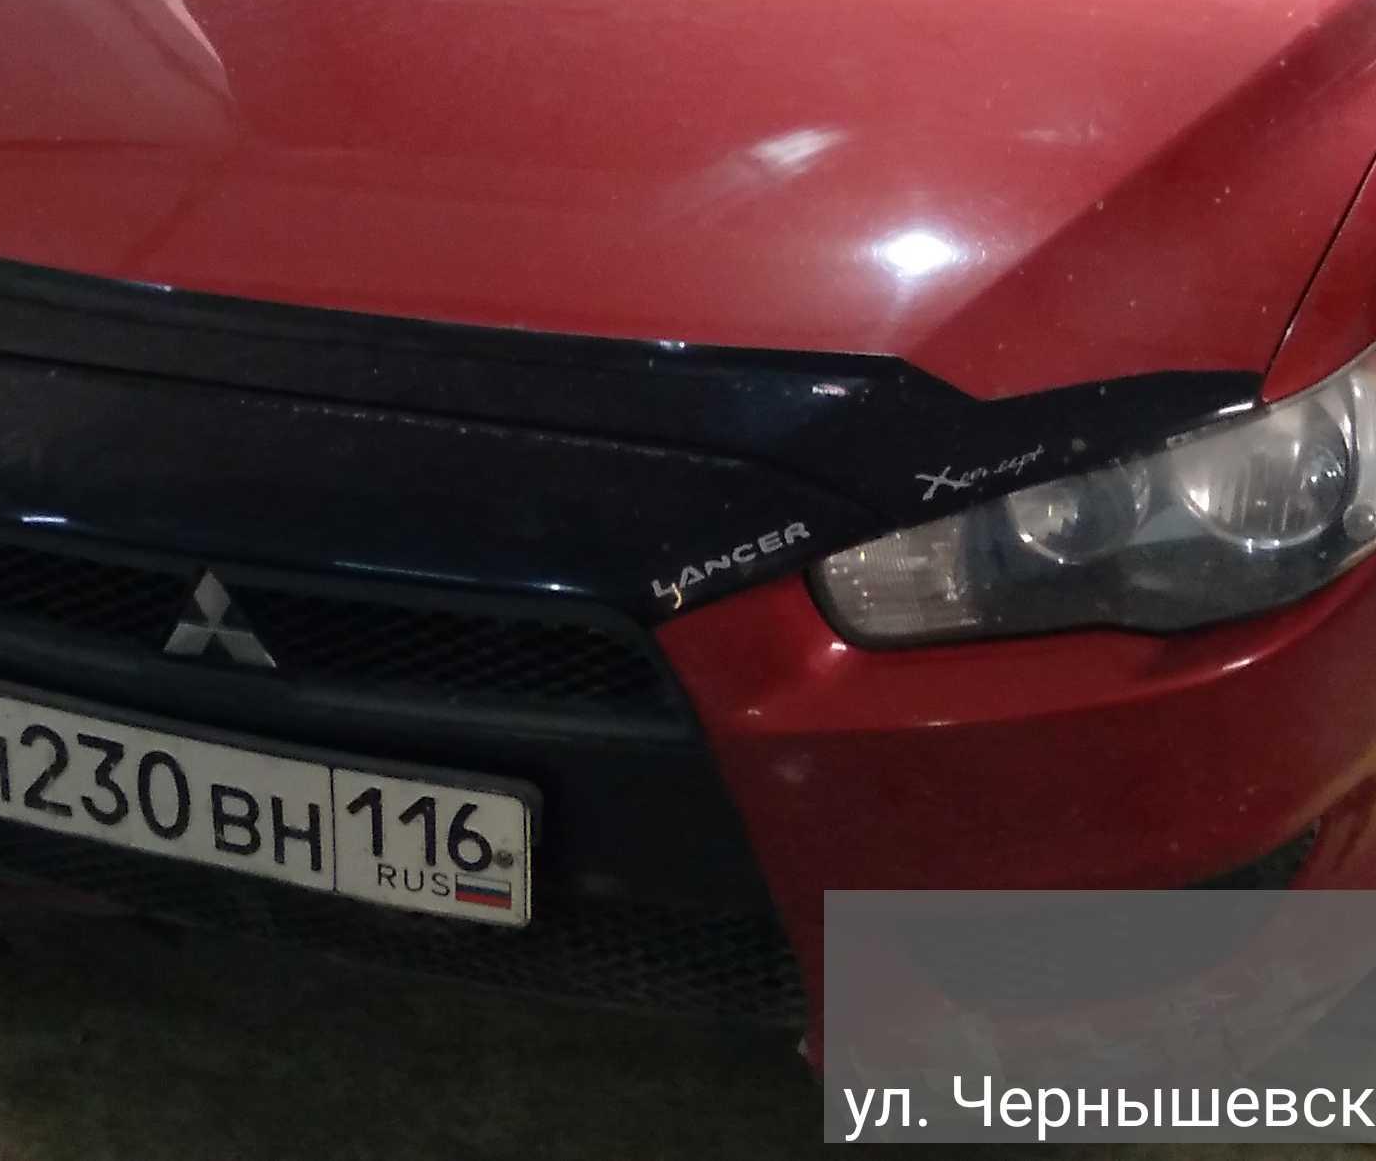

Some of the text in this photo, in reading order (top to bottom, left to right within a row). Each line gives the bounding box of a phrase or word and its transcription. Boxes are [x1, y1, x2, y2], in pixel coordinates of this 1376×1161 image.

[651, 521, 811, 610] LANCER
[346, 786, 493, 872] 116
[376, 862, 451, 898] RUS
